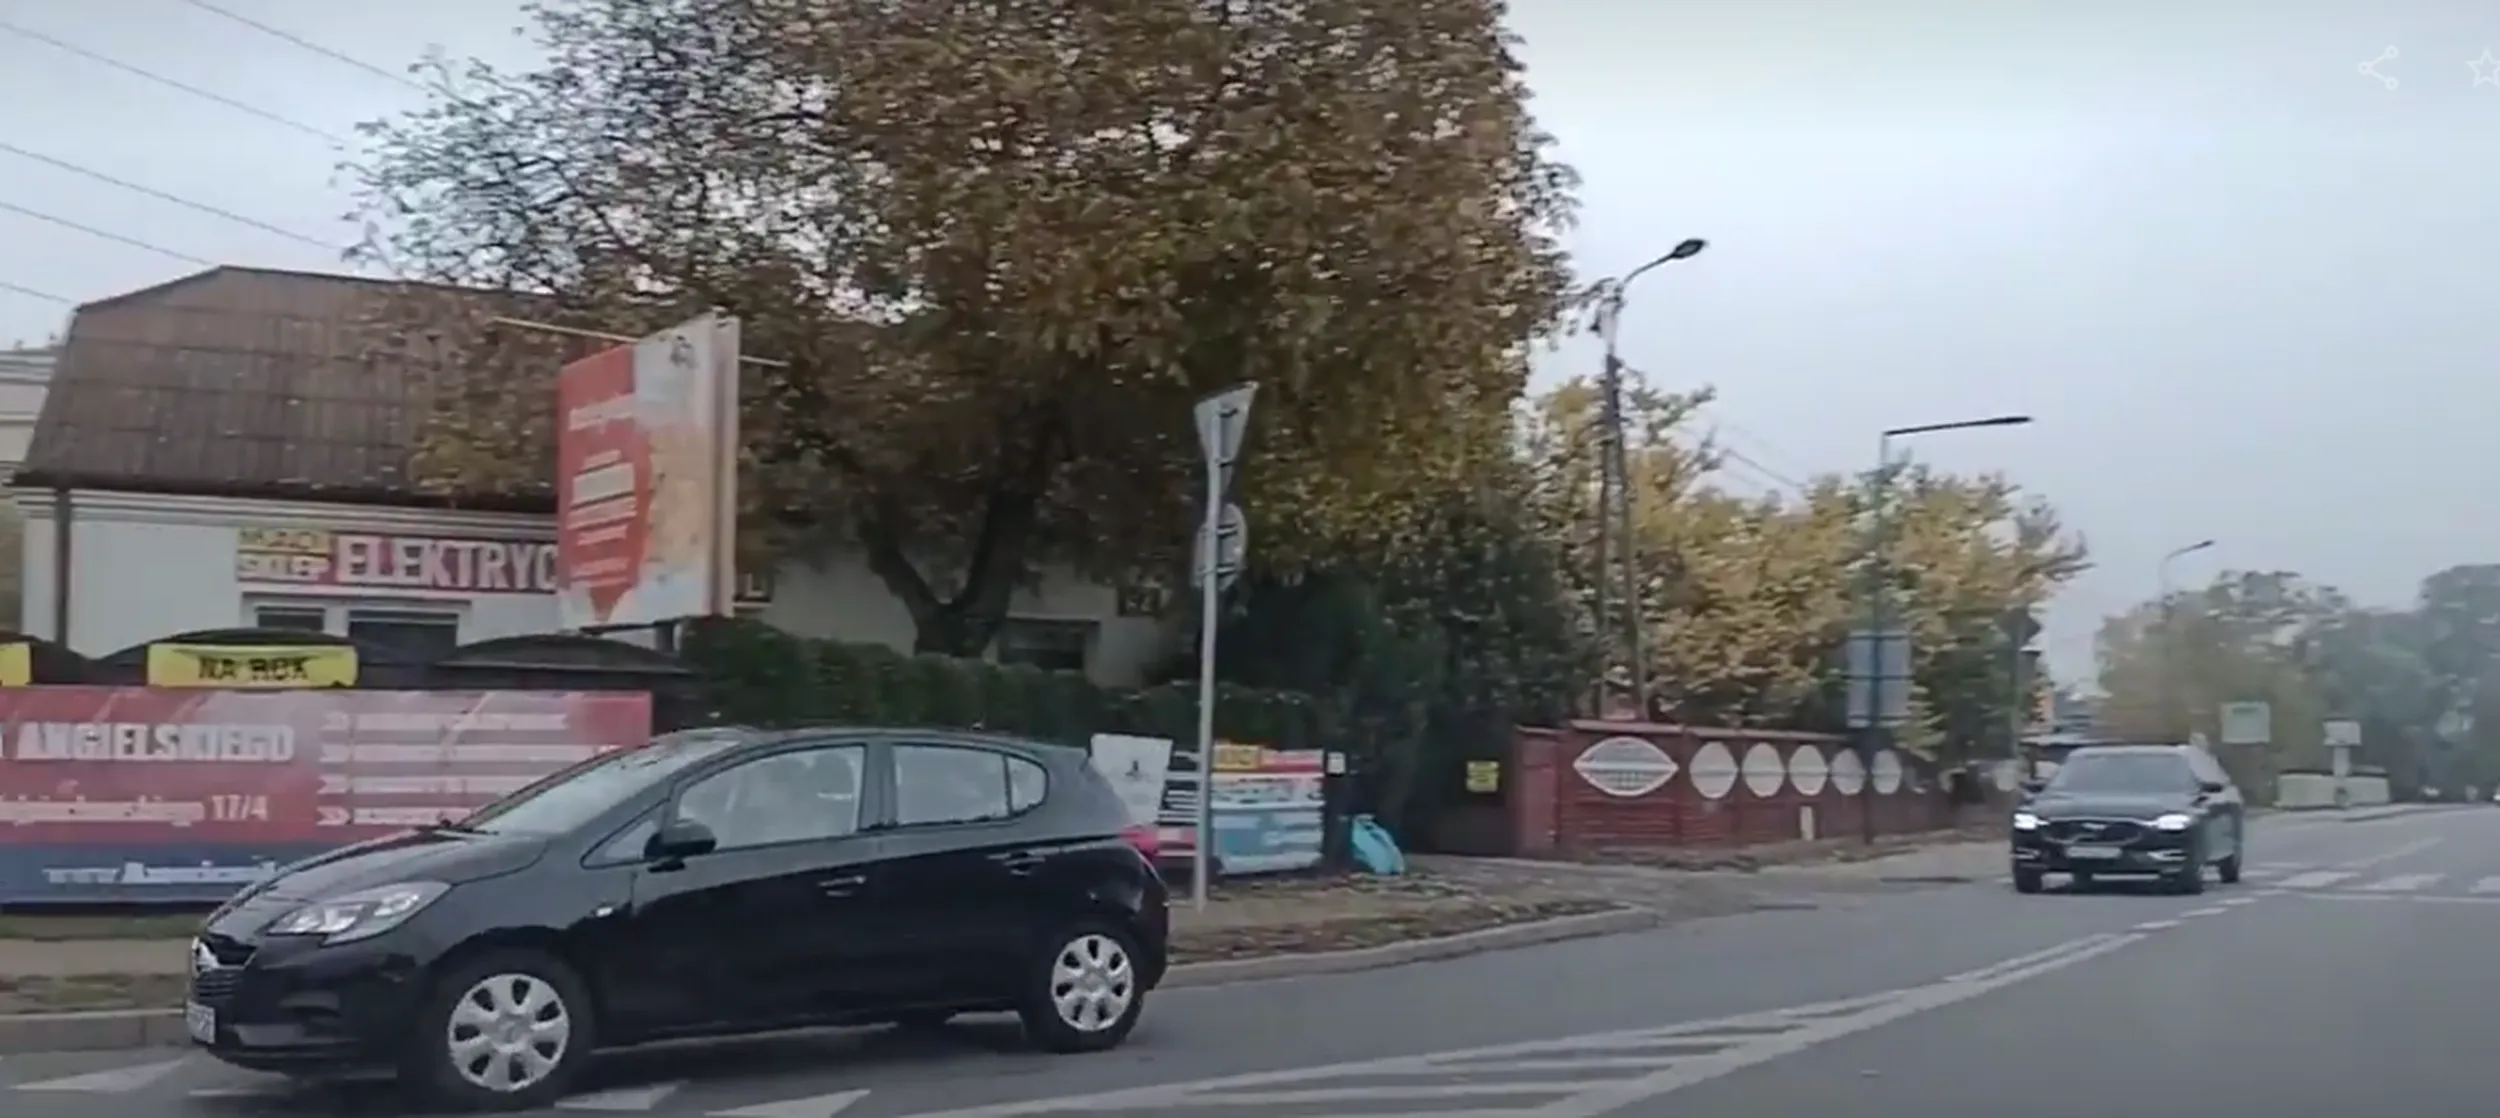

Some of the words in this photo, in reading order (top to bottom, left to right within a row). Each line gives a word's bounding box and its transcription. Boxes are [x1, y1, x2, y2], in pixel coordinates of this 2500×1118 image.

[199, 655, 238, 679] NA
[250, 657, 309, 681] ROK
[15, 722, 295, 761] ANGIELSKIEGO
[212, 795, 268, 821] 17/4
